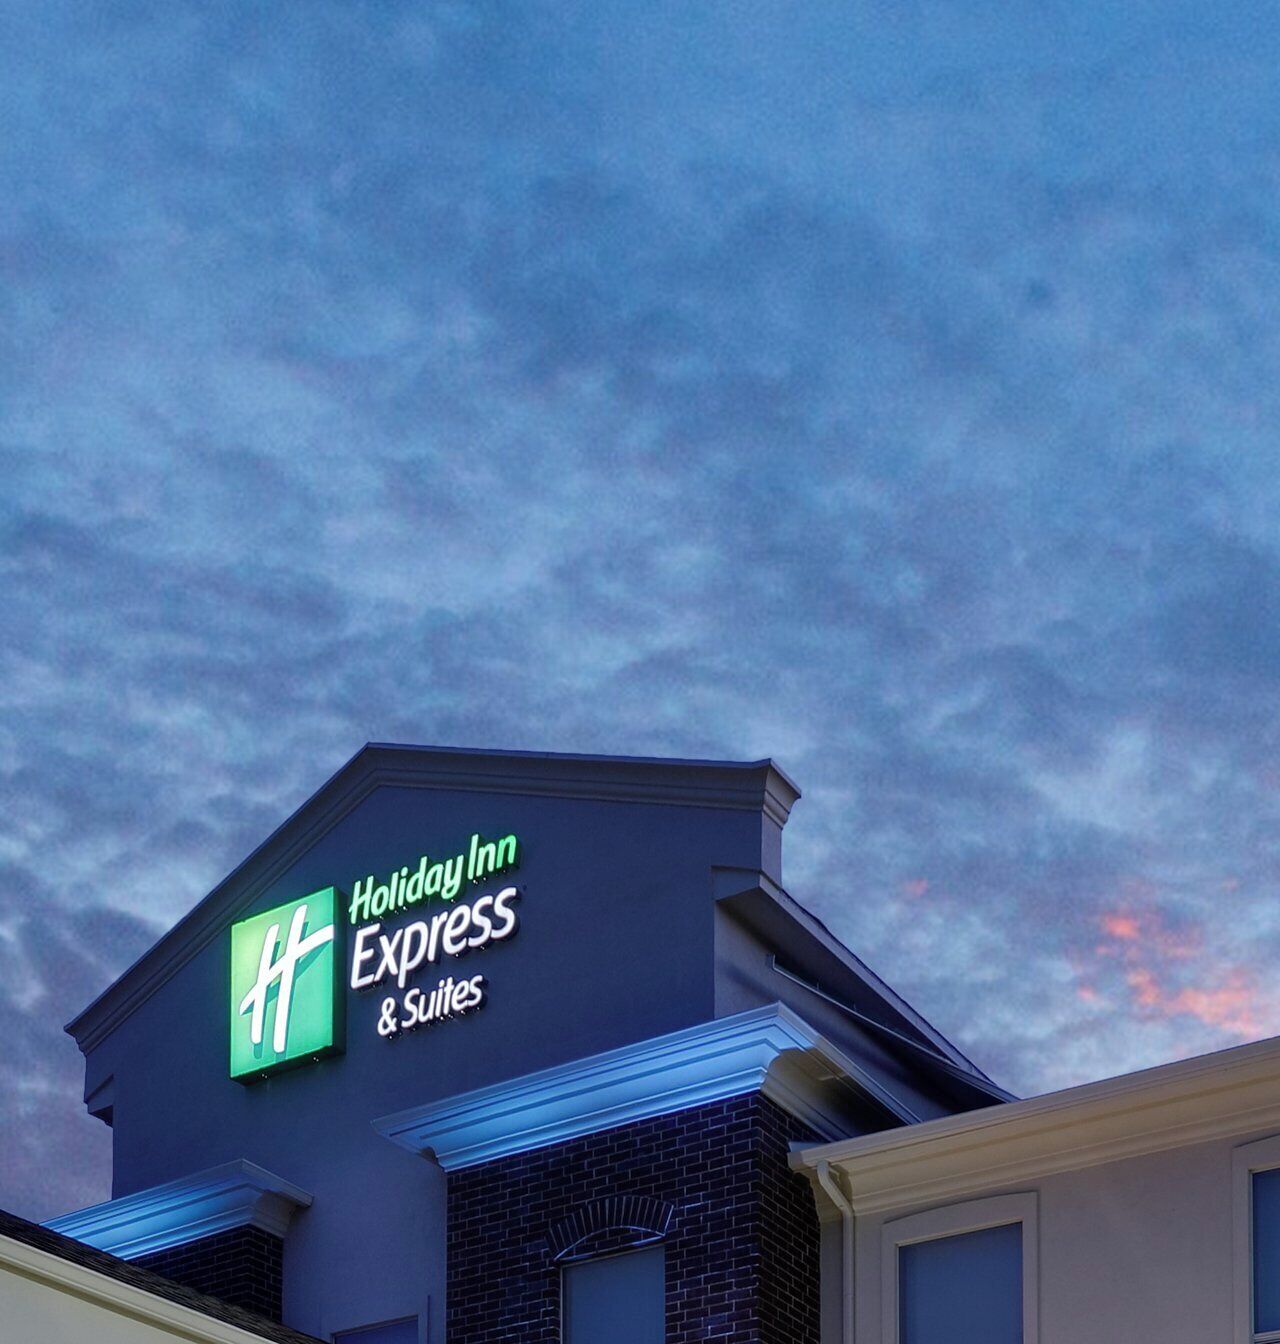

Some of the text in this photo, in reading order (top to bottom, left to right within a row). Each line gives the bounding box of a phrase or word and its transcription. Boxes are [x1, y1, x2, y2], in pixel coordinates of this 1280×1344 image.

[348, 833, 517, 924] Holiday Inn
[351, 887, 517, 989] Express
[377, 975, 483, 1036] & Suites
